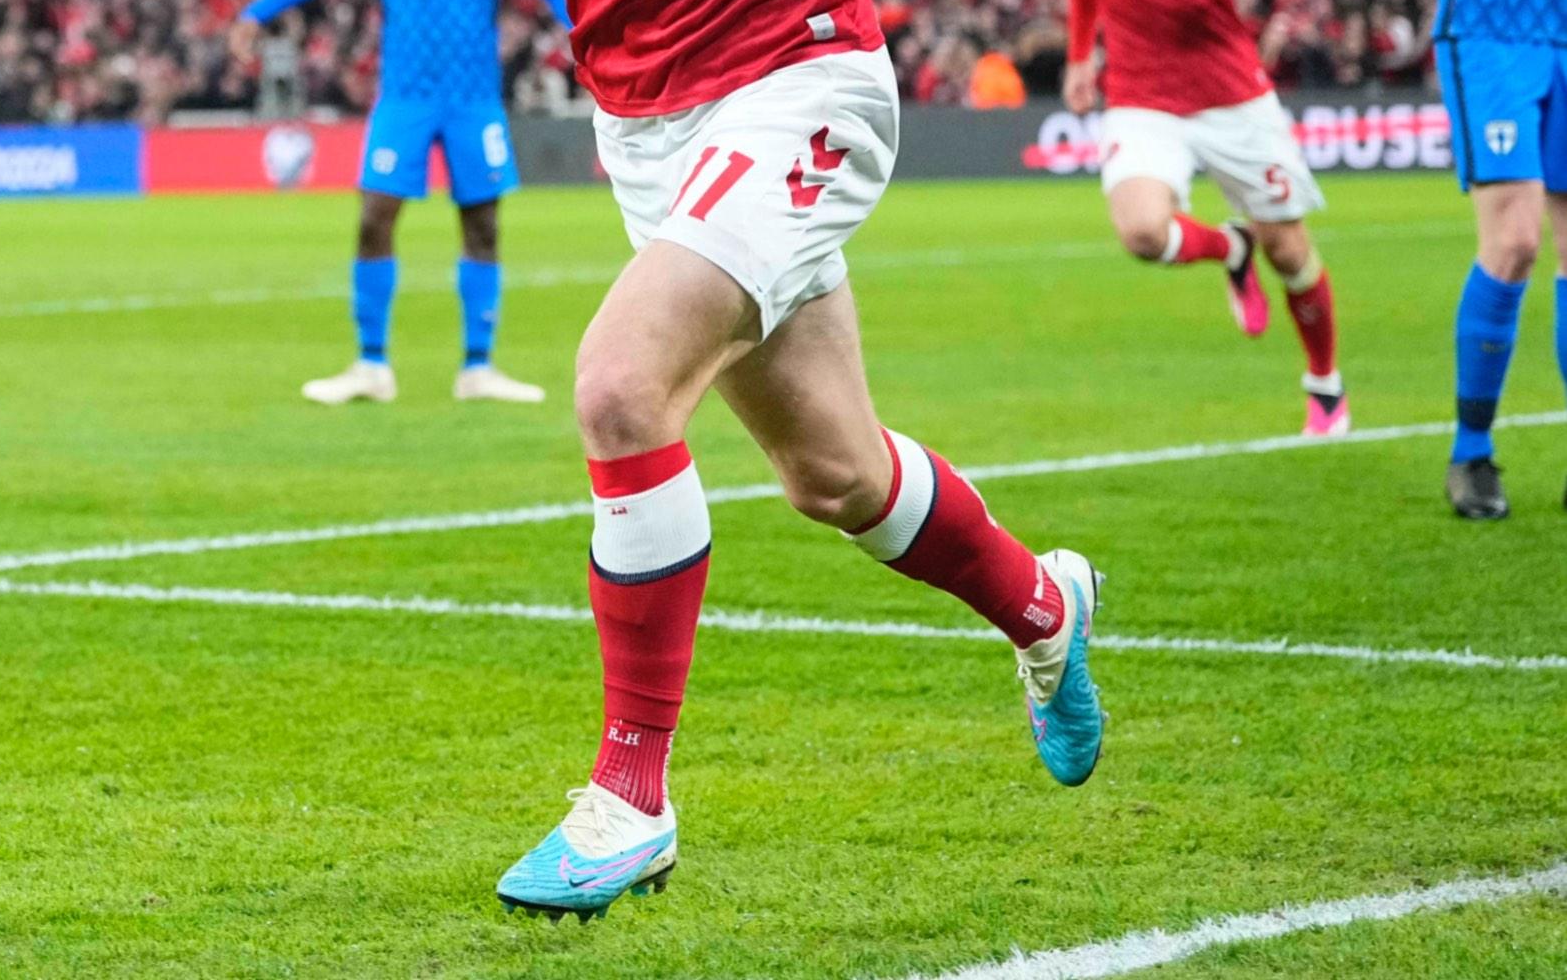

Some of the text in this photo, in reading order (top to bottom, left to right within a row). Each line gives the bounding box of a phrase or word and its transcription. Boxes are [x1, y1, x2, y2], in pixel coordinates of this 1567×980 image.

[482, 122, 508, 168] 6
[1299, 103, 1451, 169] BUSE
[667, 146, 755, 222] 11
[1264, 163, 1291, 205] 5
